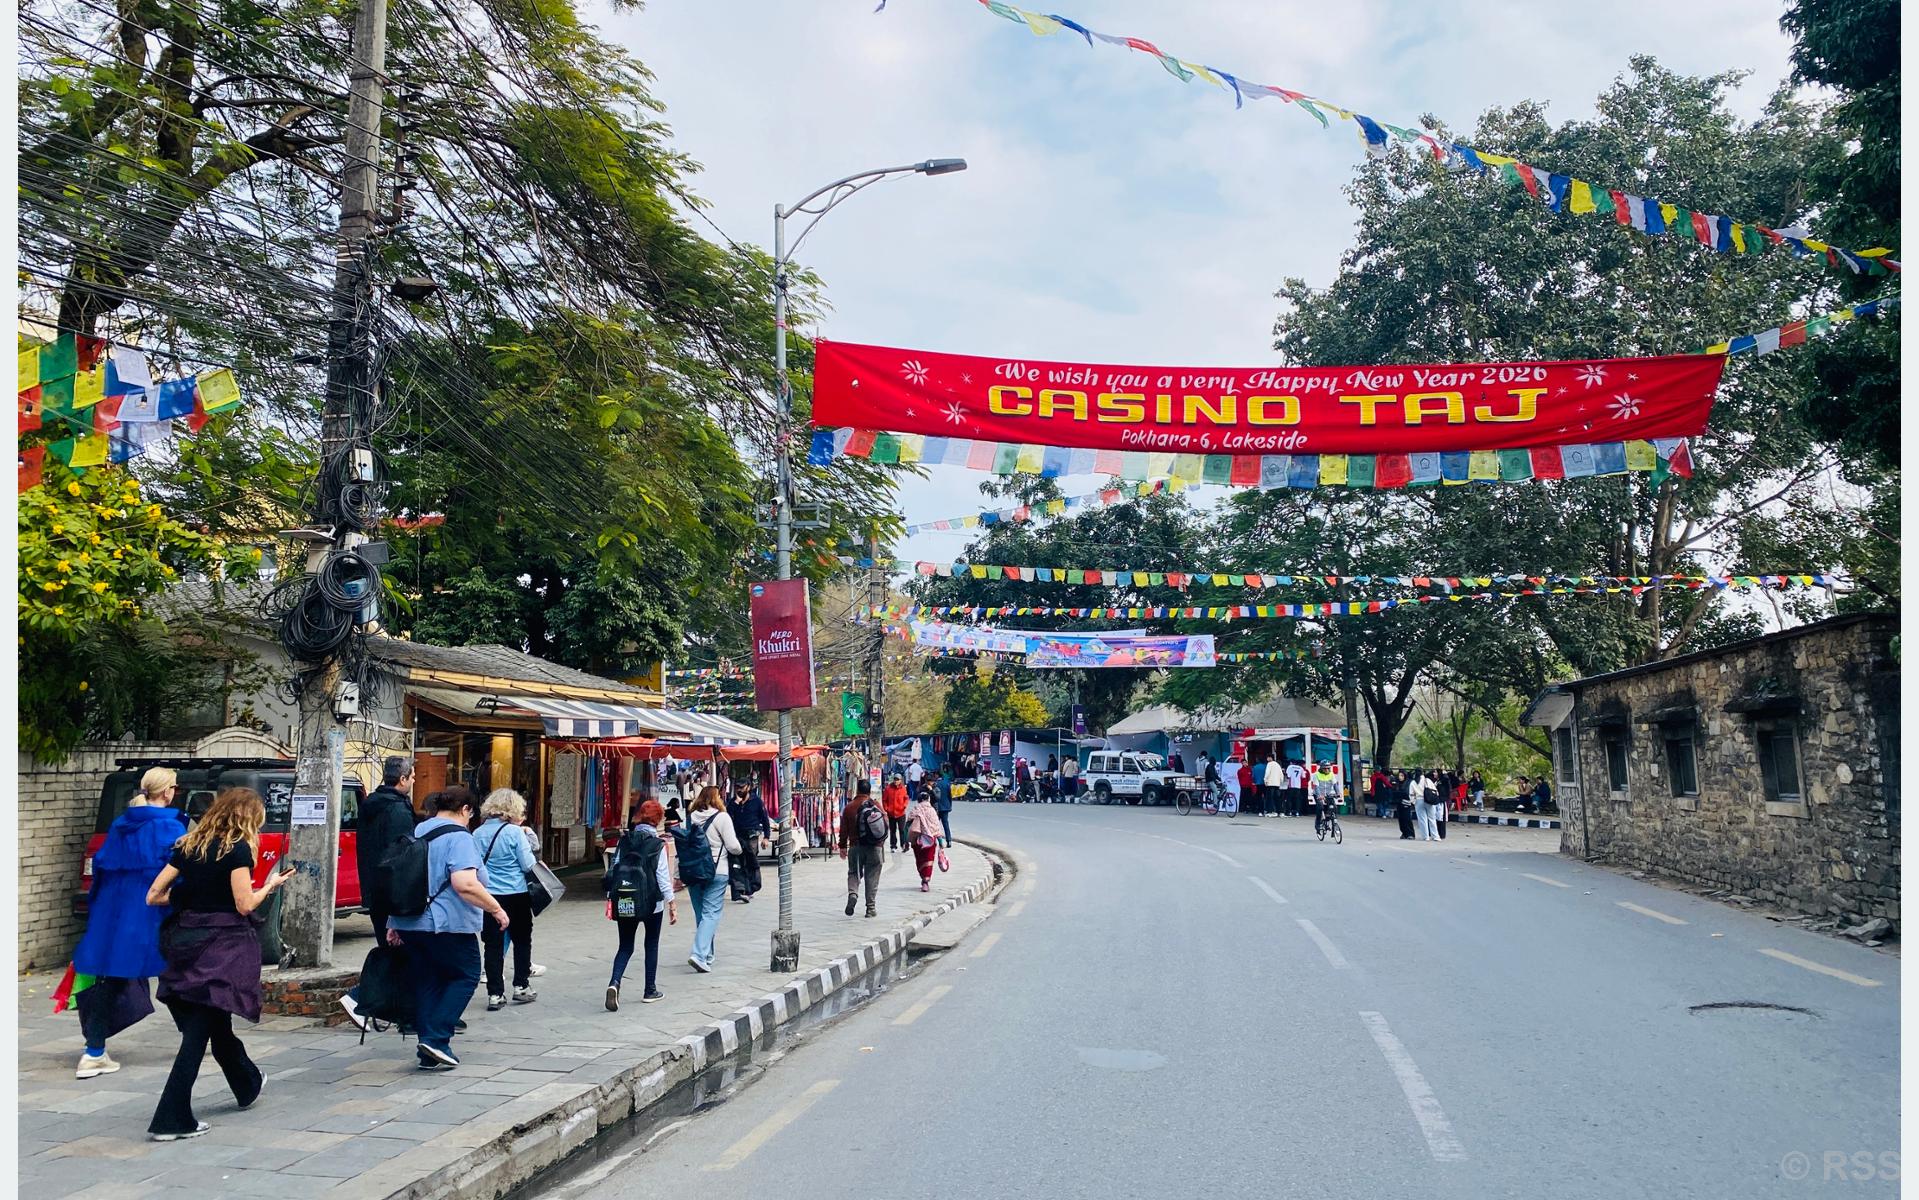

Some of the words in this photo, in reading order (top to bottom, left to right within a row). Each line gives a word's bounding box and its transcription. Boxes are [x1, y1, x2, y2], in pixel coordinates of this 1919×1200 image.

[995, 362, 1040, 382] We
[1048, 368, 1099, 386] wish
[1106, 374, 1148, 394] you
[1157, 376, 1173, 388] a
[1180, 375, 1241, 394] very
[1243, 371, 1344, 395] Happy
[1345, 370, 1404, 391] New
[1413, 369, 1475, 388] Year
[1481, 366, 1547, 385] 2026
[988, 385, 1303, 424] CASINO
[1339, 388, 1548, 425] TAJ
[1222, 430, 1308, 450] Lakeside
[758, 637, 800, 653] Khukri
[770, 631, 792, 639] MERO
